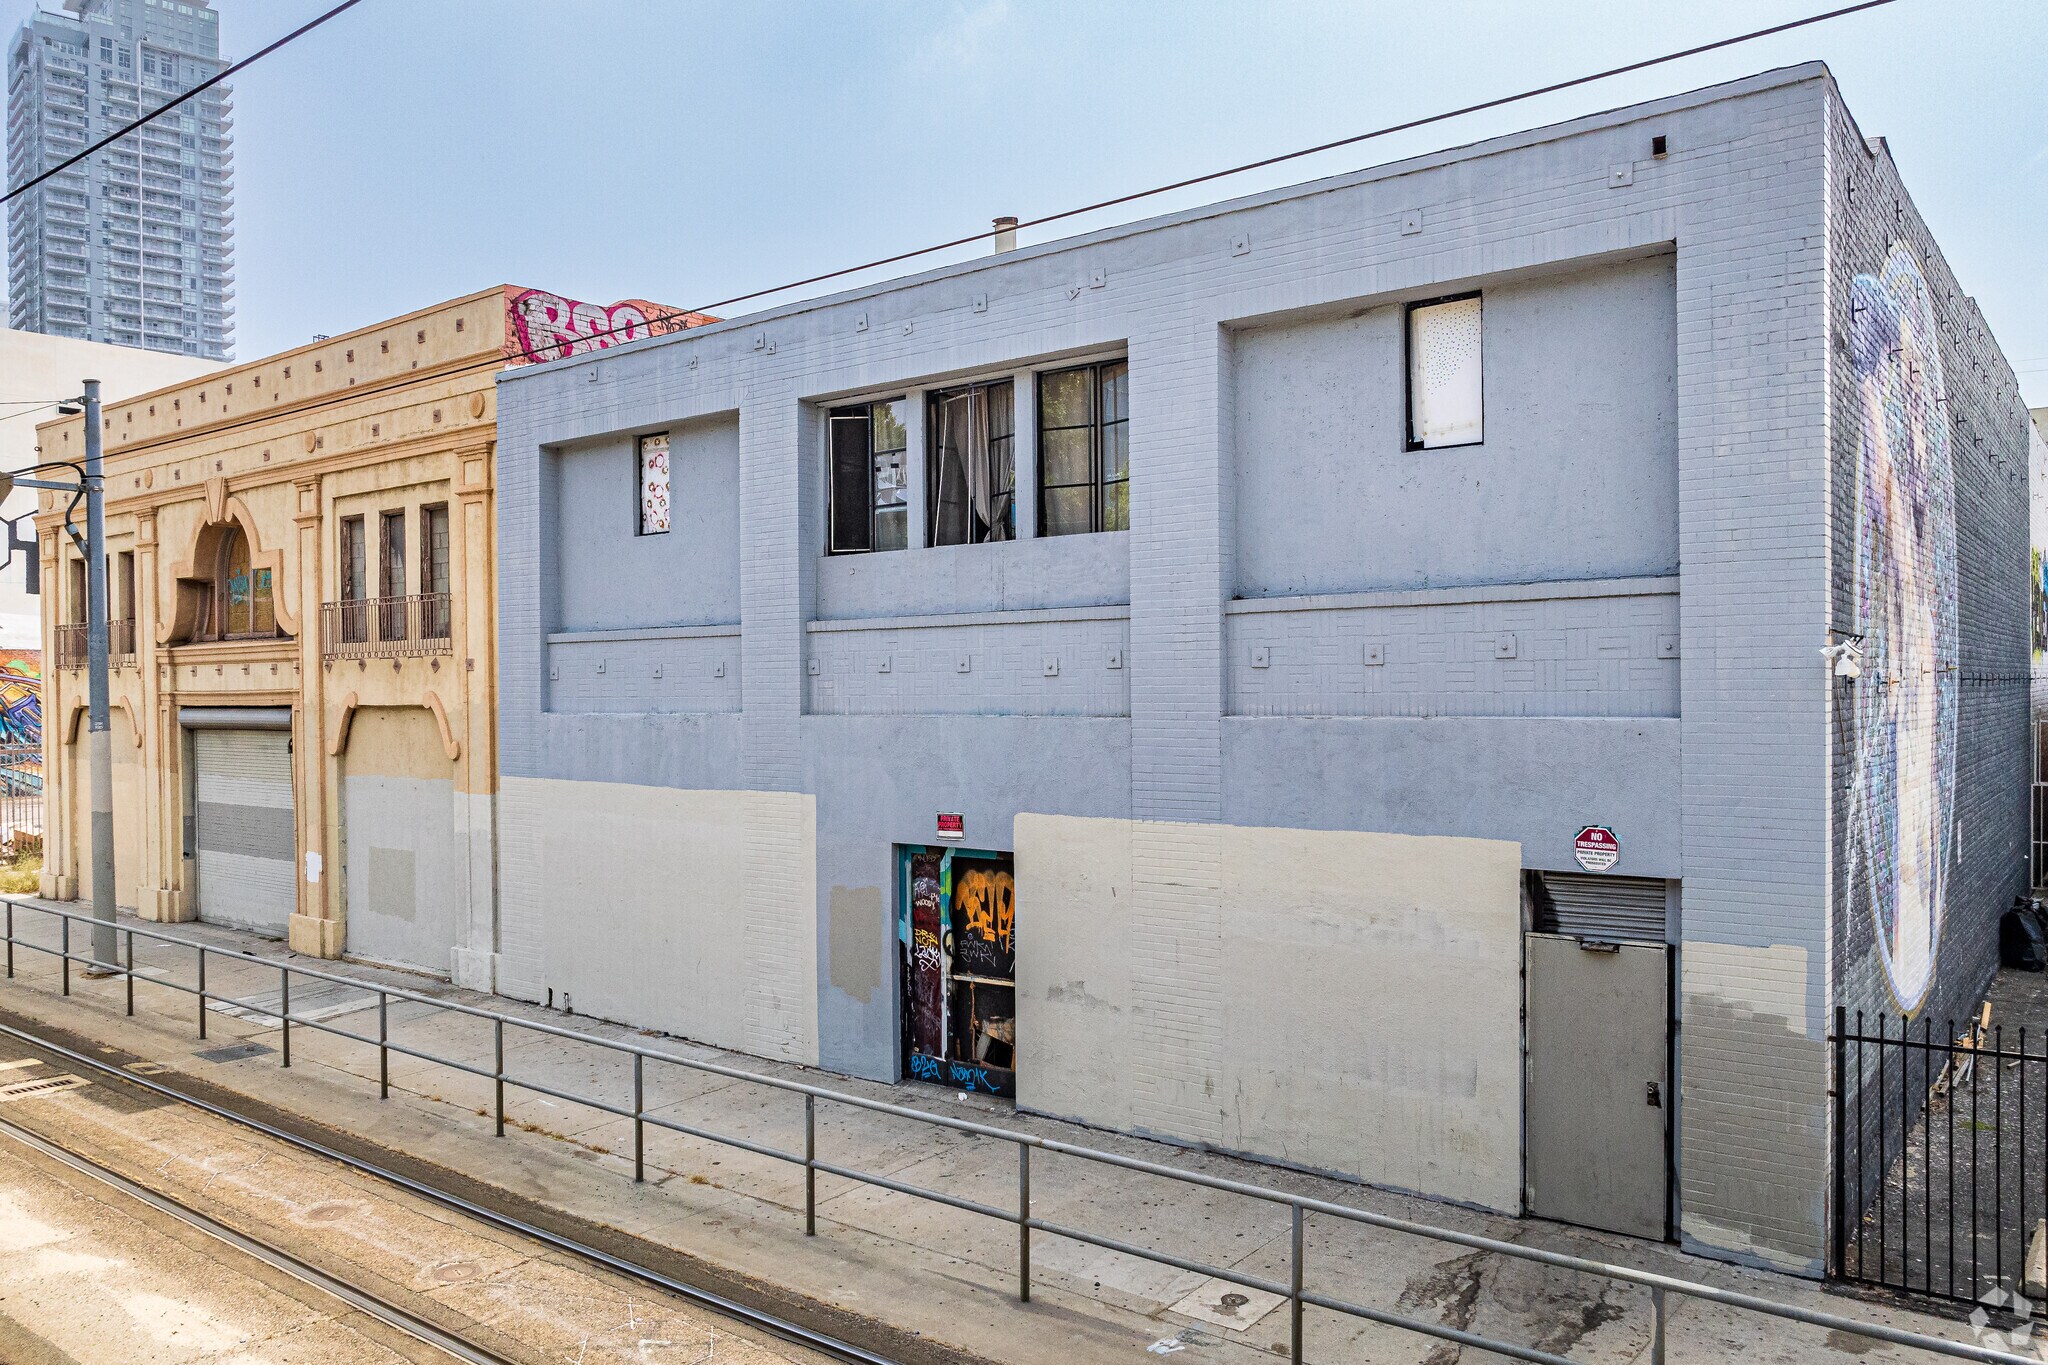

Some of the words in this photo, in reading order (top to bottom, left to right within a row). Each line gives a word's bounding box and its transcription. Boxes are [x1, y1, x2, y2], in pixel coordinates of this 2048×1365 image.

[938, 821, 963, 829] PROPERTY
[1591, 832, 1603, 841] NO
[1577, 841, 1616, 850] TRESPASSING
